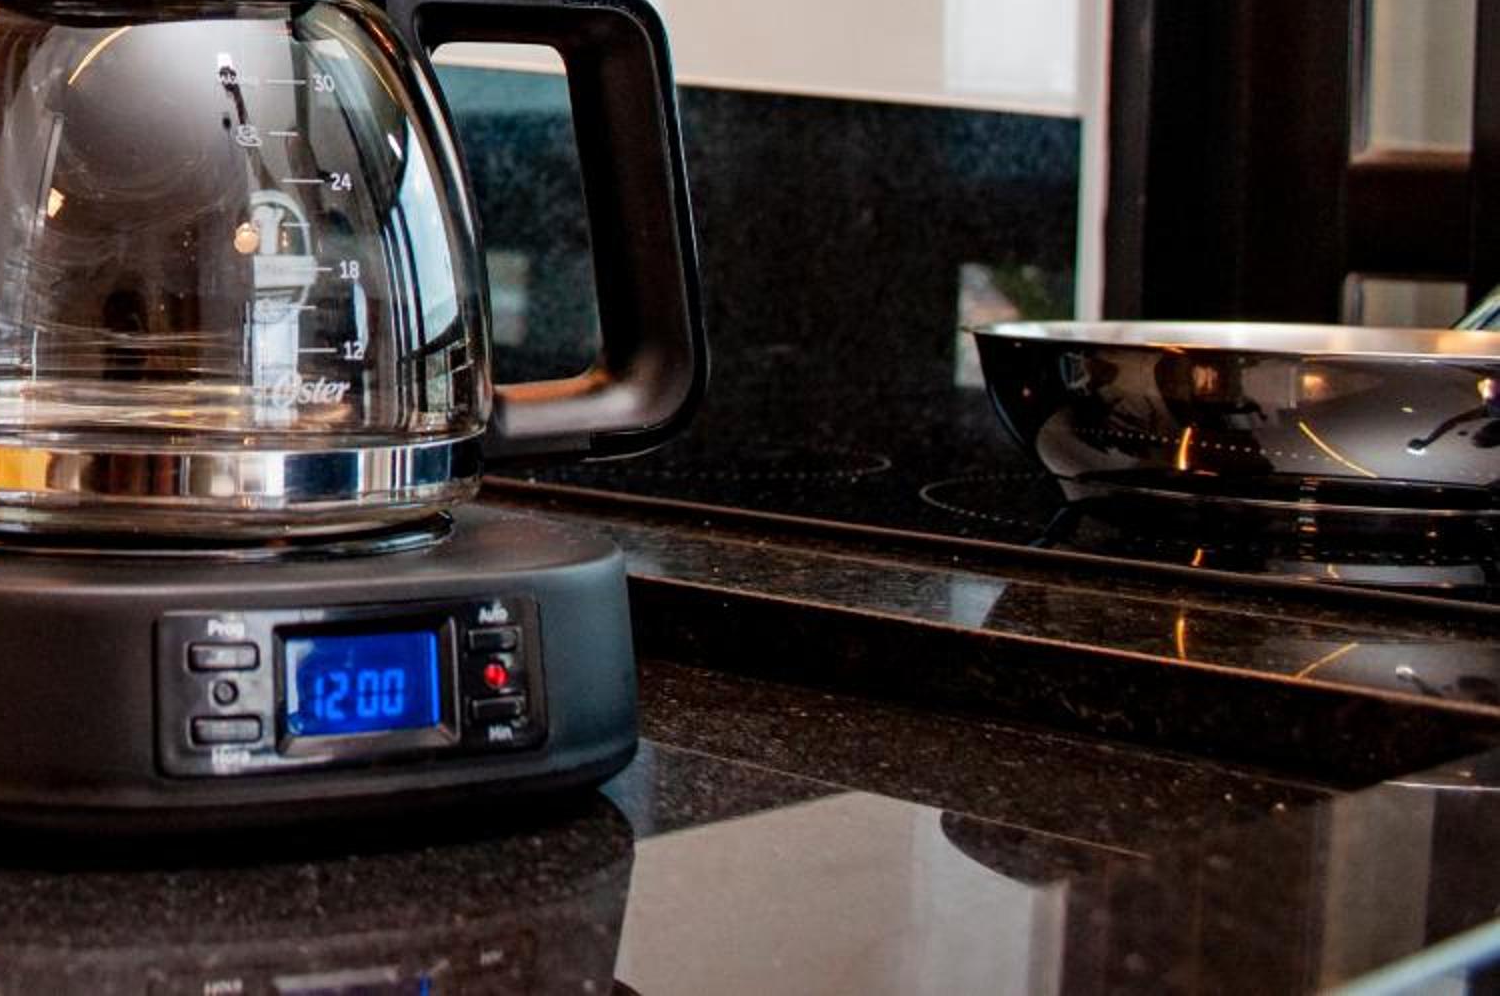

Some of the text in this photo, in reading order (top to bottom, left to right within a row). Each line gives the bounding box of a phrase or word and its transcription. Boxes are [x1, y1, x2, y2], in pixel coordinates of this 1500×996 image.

[313, 74, 336, 93] 30
[330, 172, 352, 191] 24
[339, 260, 360, 280] 18
[343, 340, 364, 360] 12
[271, 372, 352, 410] Oster
